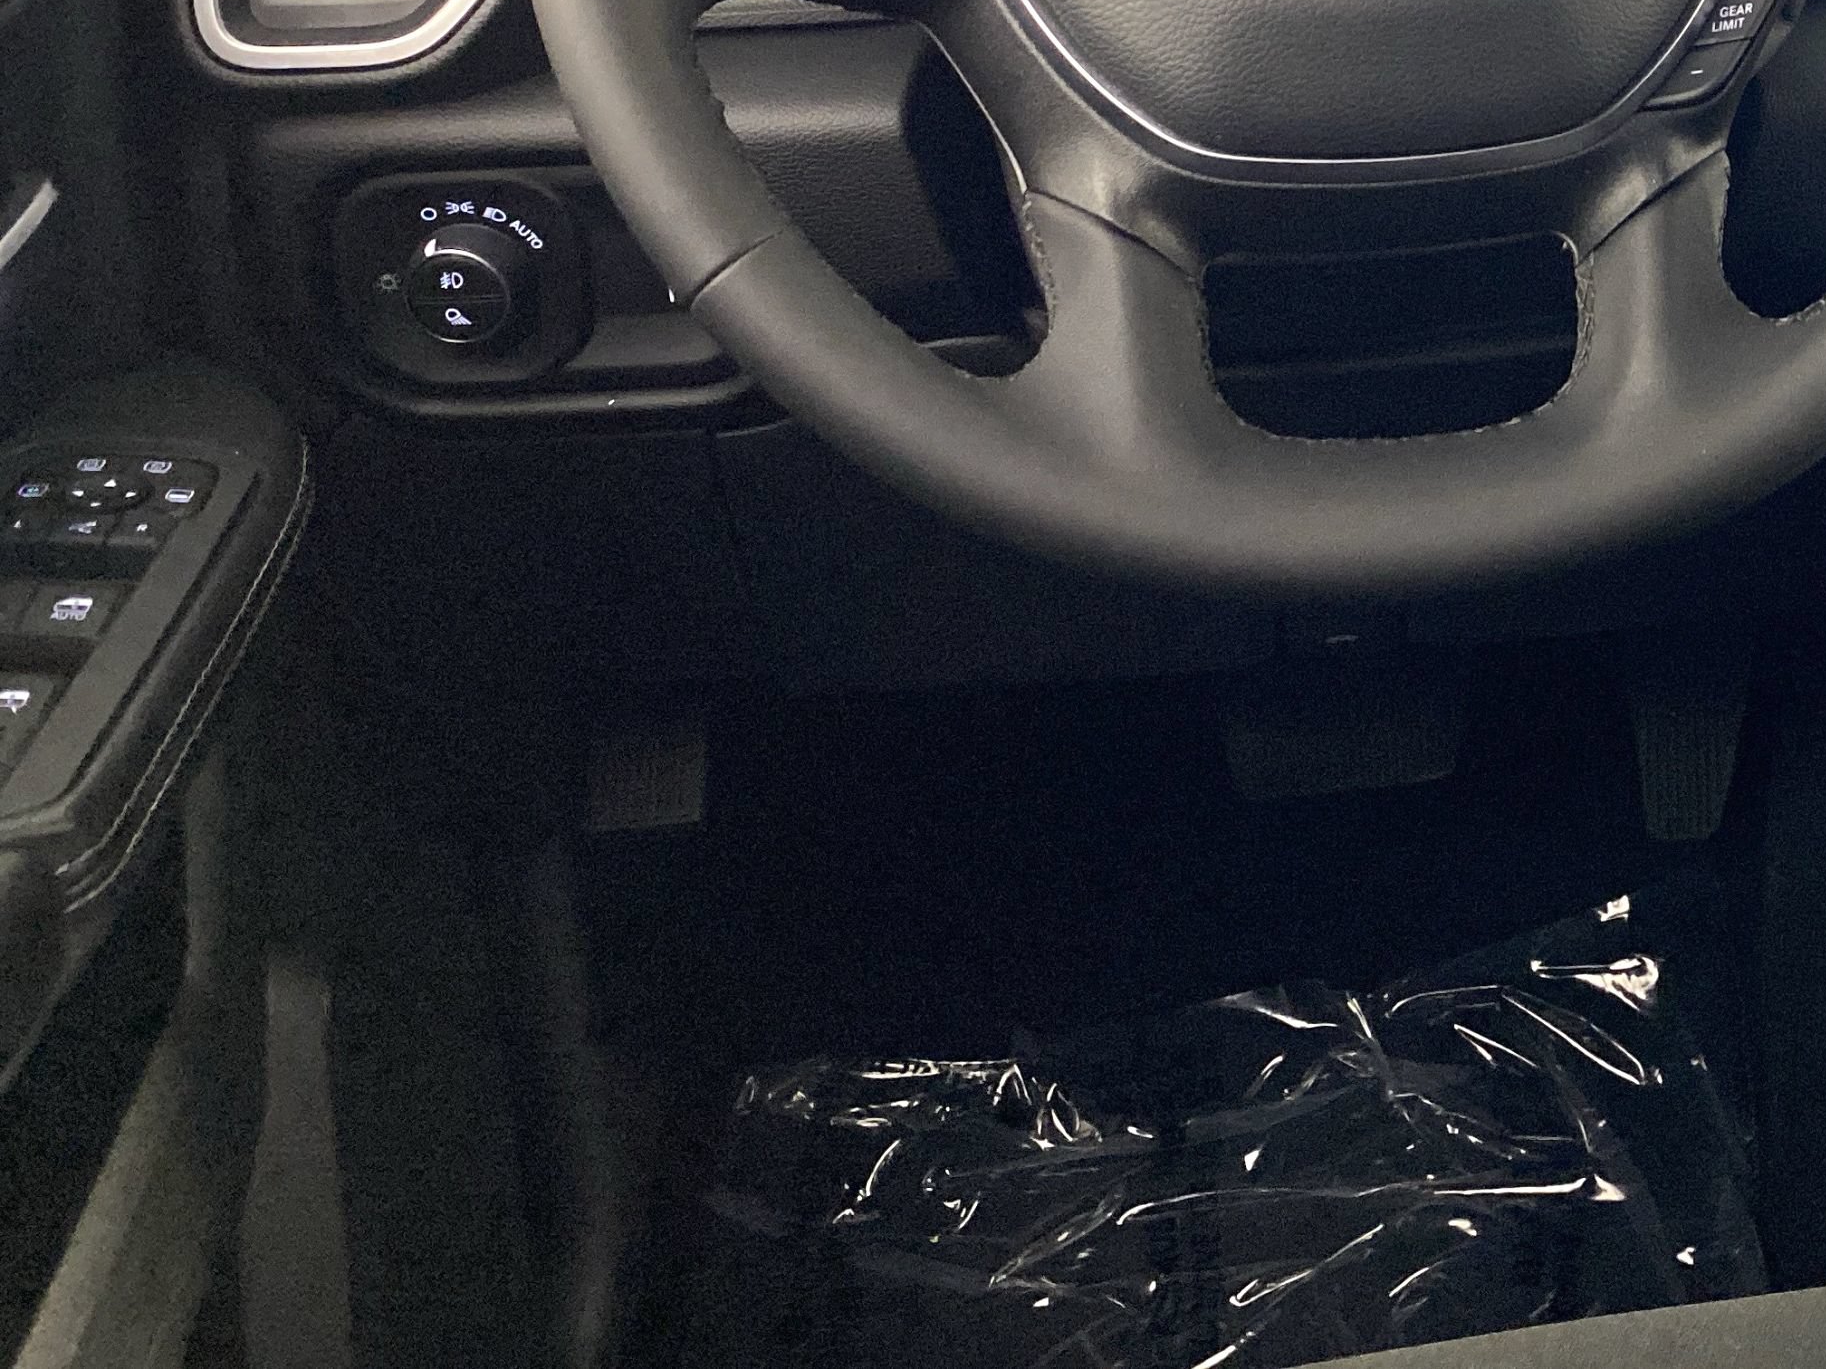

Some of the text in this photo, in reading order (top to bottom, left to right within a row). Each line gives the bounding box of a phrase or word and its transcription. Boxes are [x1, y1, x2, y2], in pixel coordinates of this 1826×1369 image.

[1720, 2, 1753, 18] GEAR
[1711, 17, 1745, 32] LIMIT
[509, 220, 543, 250] AUTO
